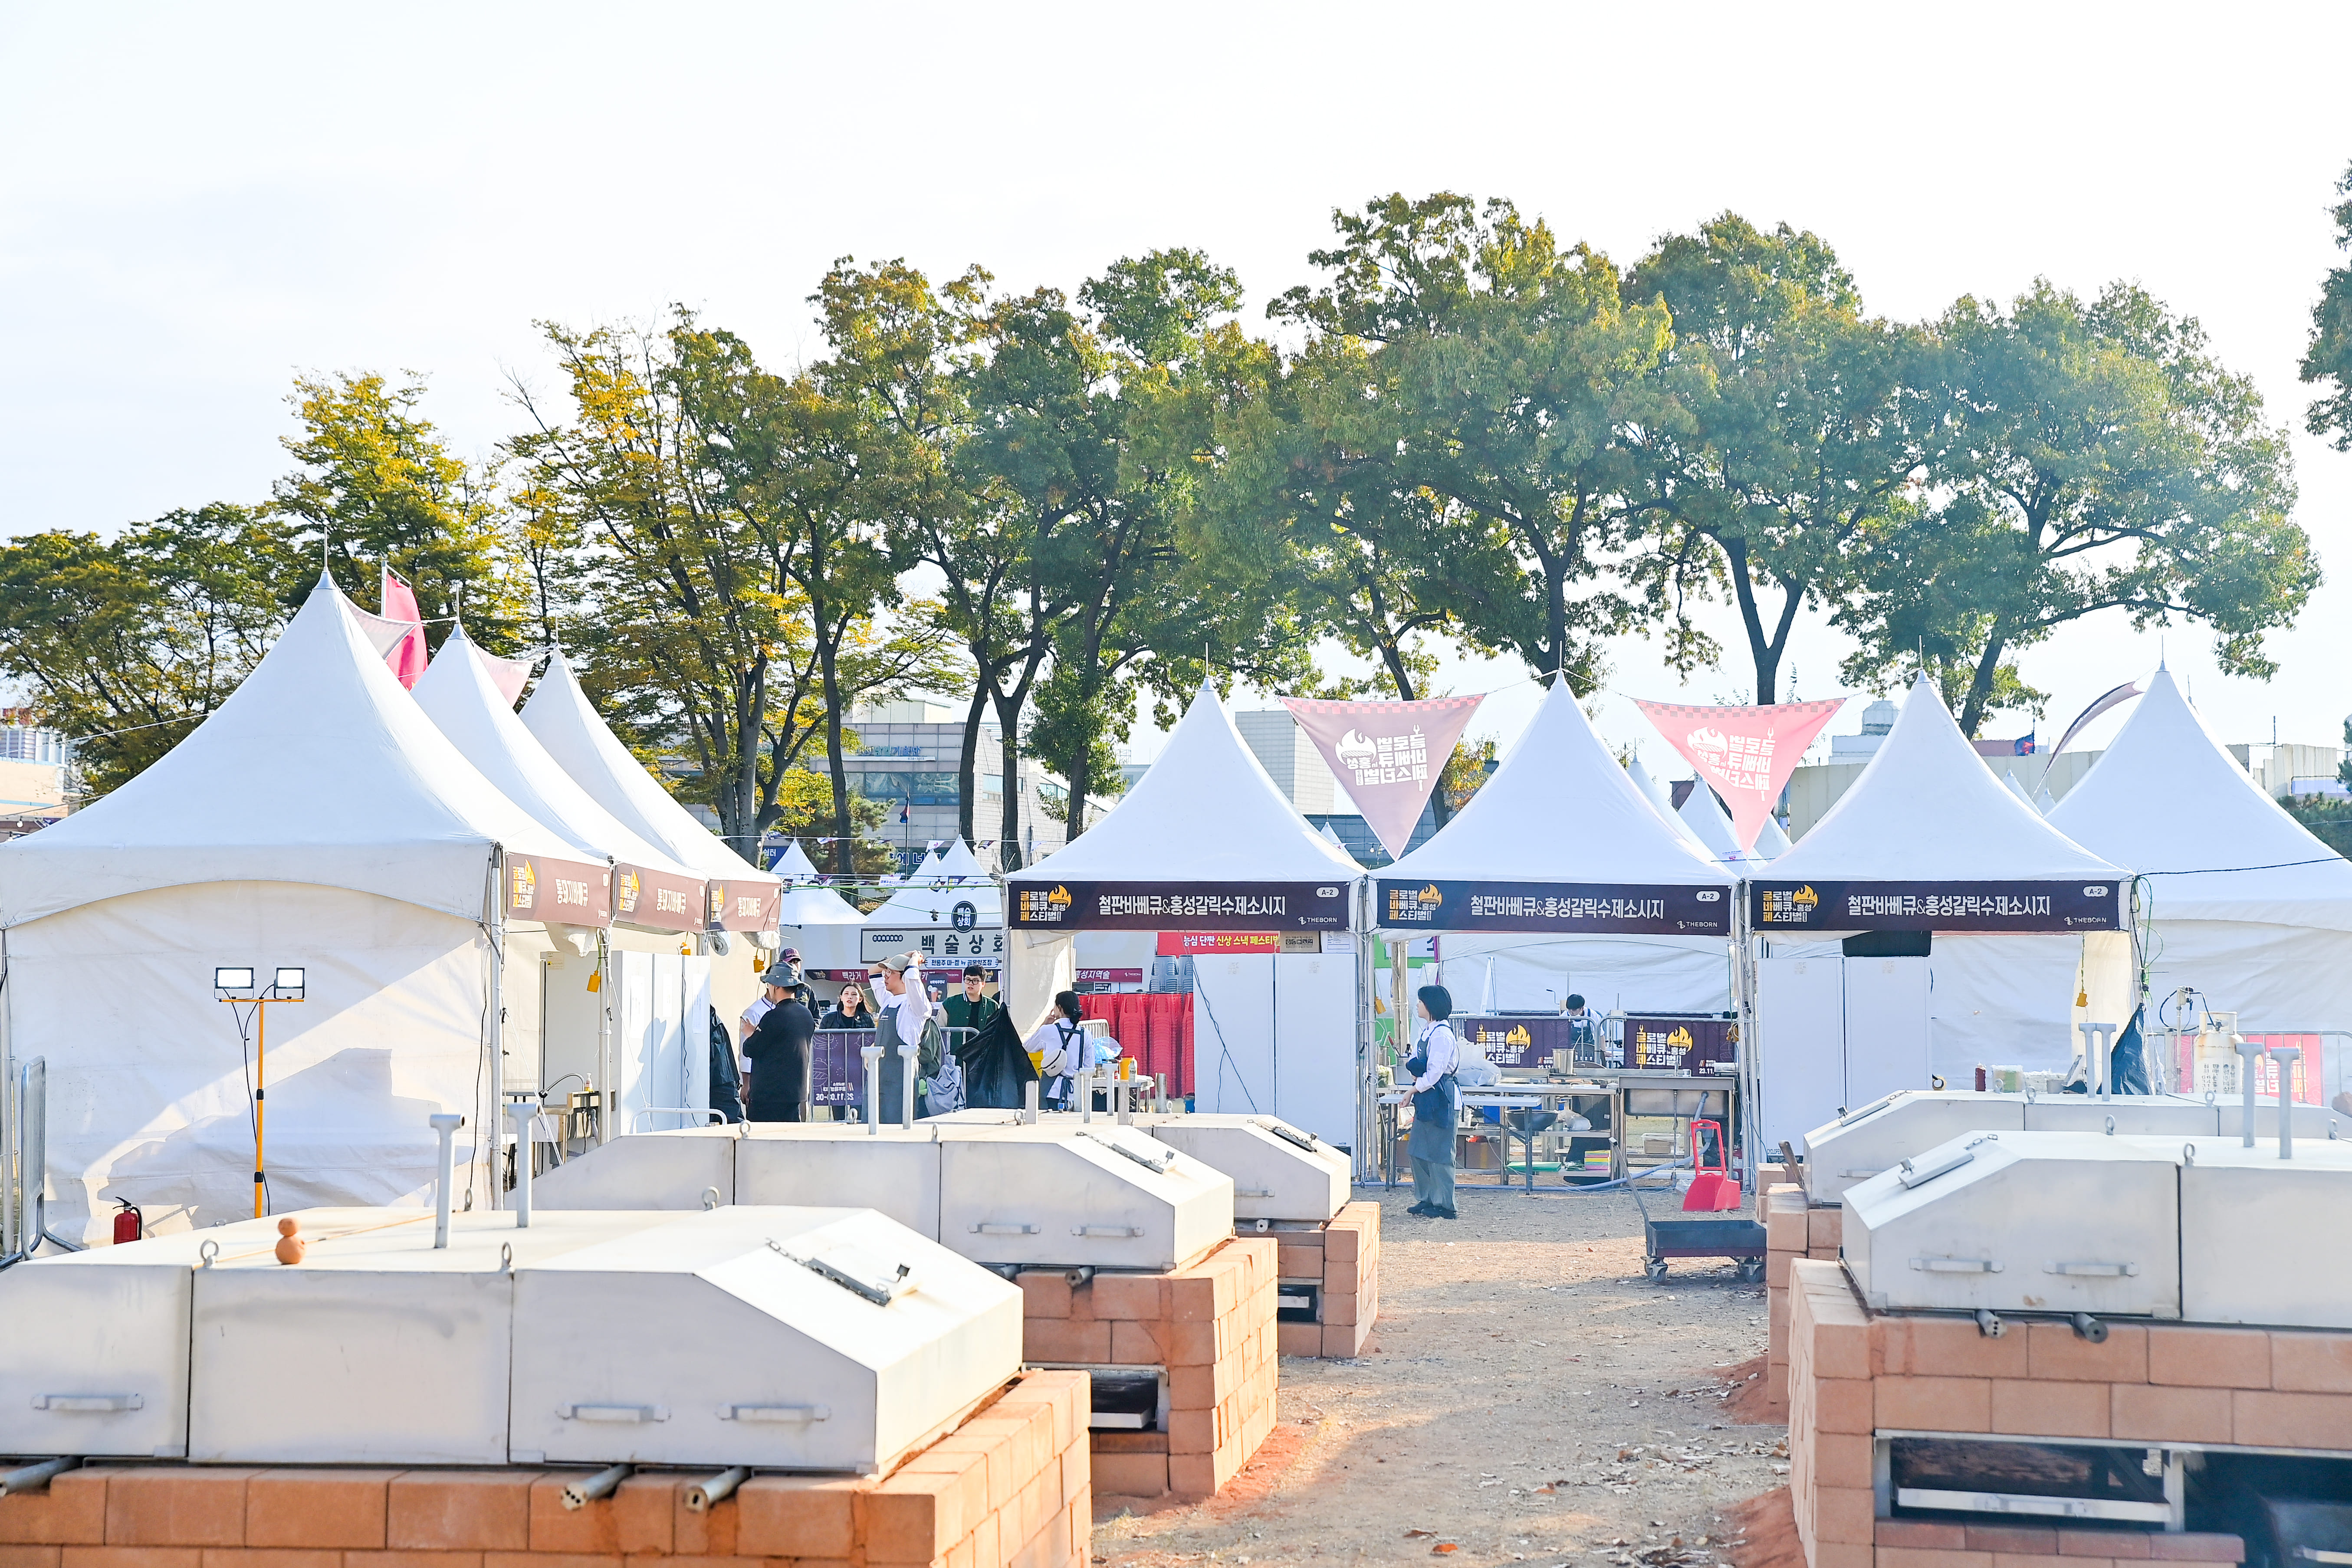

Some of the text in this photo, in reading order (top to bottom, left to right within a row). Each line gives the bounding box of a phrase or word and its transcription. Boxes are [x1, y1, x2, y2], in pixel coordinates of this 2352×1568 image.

[512, 866, 526, 880] 글로벌
[620, 874, 631, 887] 글로벌
[513, 880, 526, 894] 바베큐
[555, 878, 588, 907] 통돼지바베큐
[1020, 891, 1048, 901] 글로벌
[1390, 889, 1418, 900] 글로벌
[1763, 891, 1792, 901] 글로벌
[512, 894, 532, 908] 페스티벌
[657, 888, 687, 915] 통돼지바베큐
[1020, 901, 1048, 911] 바베큐
[1099, 895, 1285, 915] 철판바베큐&홍성갈릭수제소시지
[1390, 900, 1418, 910] 바베큐
[1763, 901, 1792, 911] 바베큐
[1848, 894, 2050, 917] 철판바베큐&홍성갈릭수제소시지
[737, 897, 761, 917] 통돼지바베큐
[1471, 895, 1664, 919] 철판바베큐&홍성갈릭수제소시지
[1020, 911, 1056, 921] 페스티벌
[1389, 910, 1426, 920] 페스티벌
[1763, 912, 1802, 922] 페스티벌
[957, 917, 970, 927] 상회
[1183, 936, 1198, 947] 농심
[1199, 936, 1215, 947] 단짠
[1216, 936, 1232, 947] 신상
[1233, 936, 1248, 946] 스낵
[1476, 1031, 1505, 1042] 글로벌
[1636, 1032, 1667, 1043] 글로벌
[1477, 1042, 1505, 1053] 베큐
[1636, 1043, 1666, 1054] 바베큐
[1485, 1053, 1516, 1064] 스티벌
